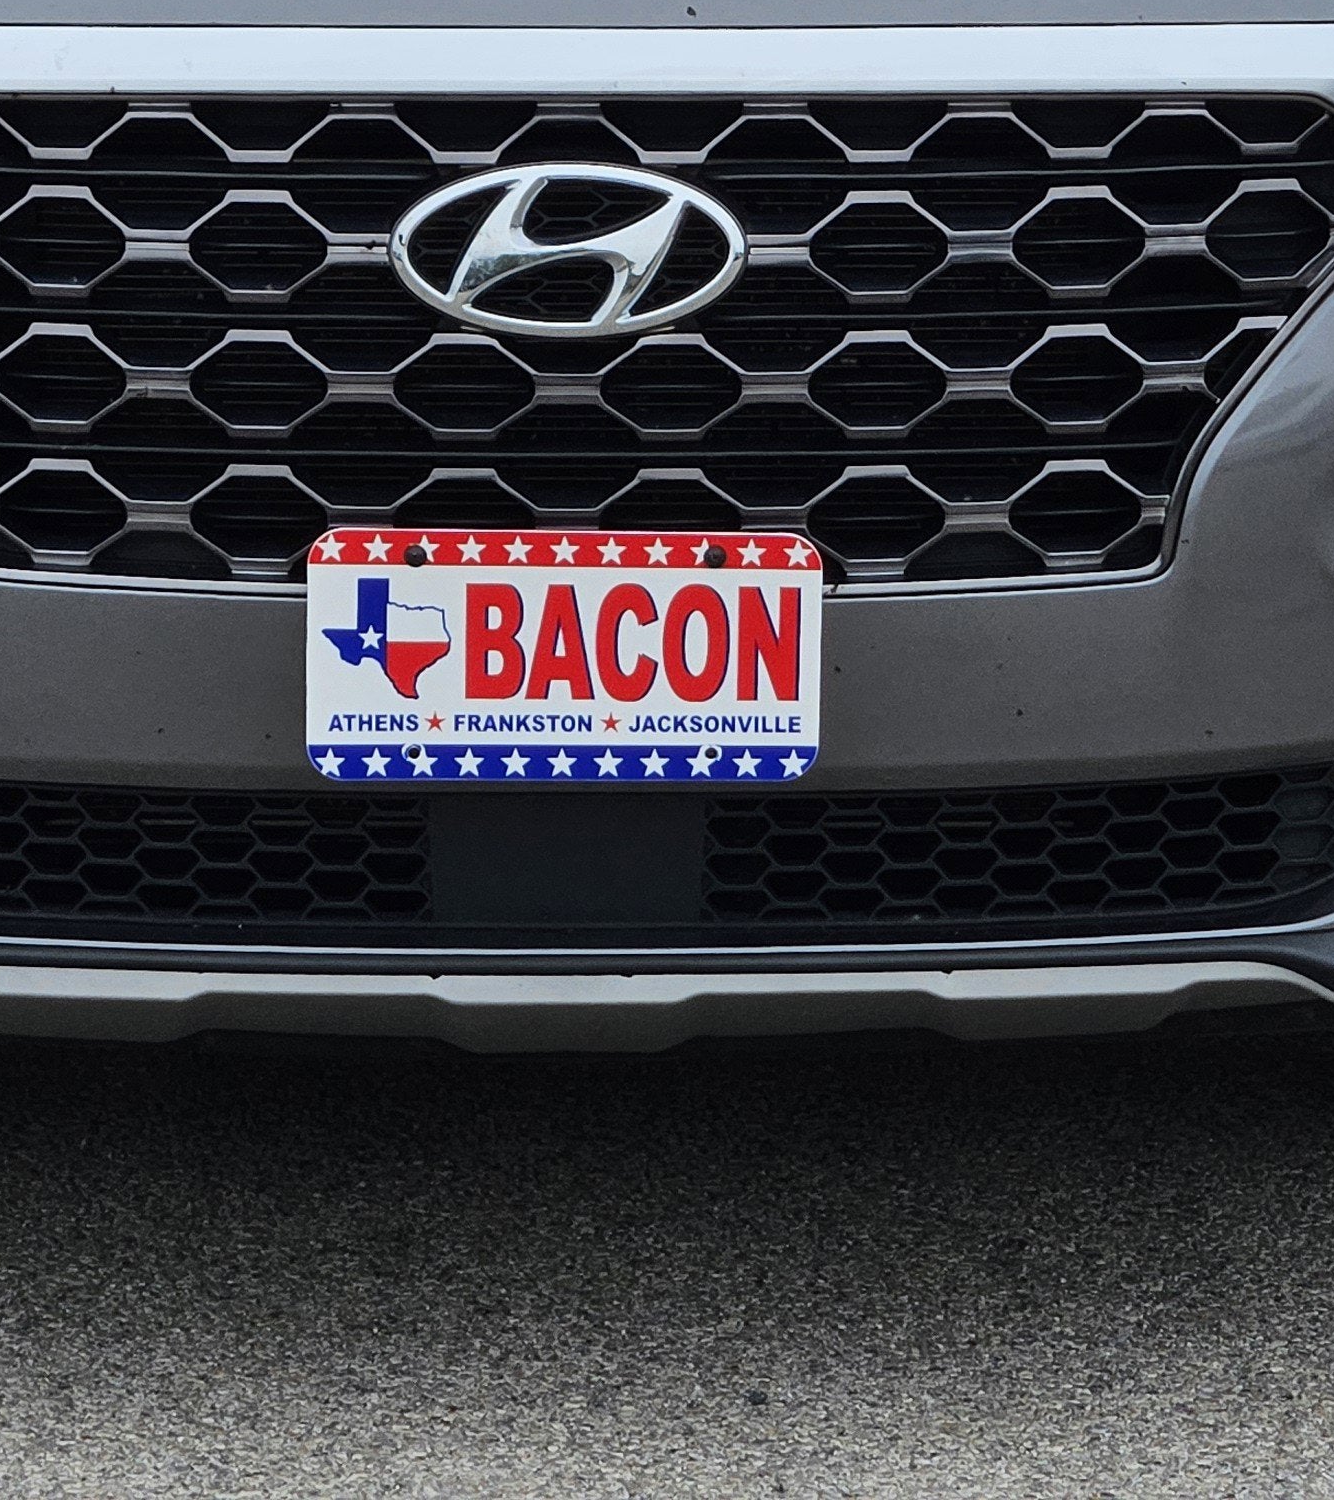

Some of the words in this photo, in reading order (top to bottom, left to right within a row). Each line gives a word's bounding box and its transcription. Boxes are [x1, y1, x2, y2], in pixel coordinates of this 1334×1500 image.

[464, 582, 802, 703] BACON
[328, 713, 419, 733] ATHENS
[453, 714, 593, 734] FRANKSTON
[628, 714, 802, 734] JACKSONVILLE
